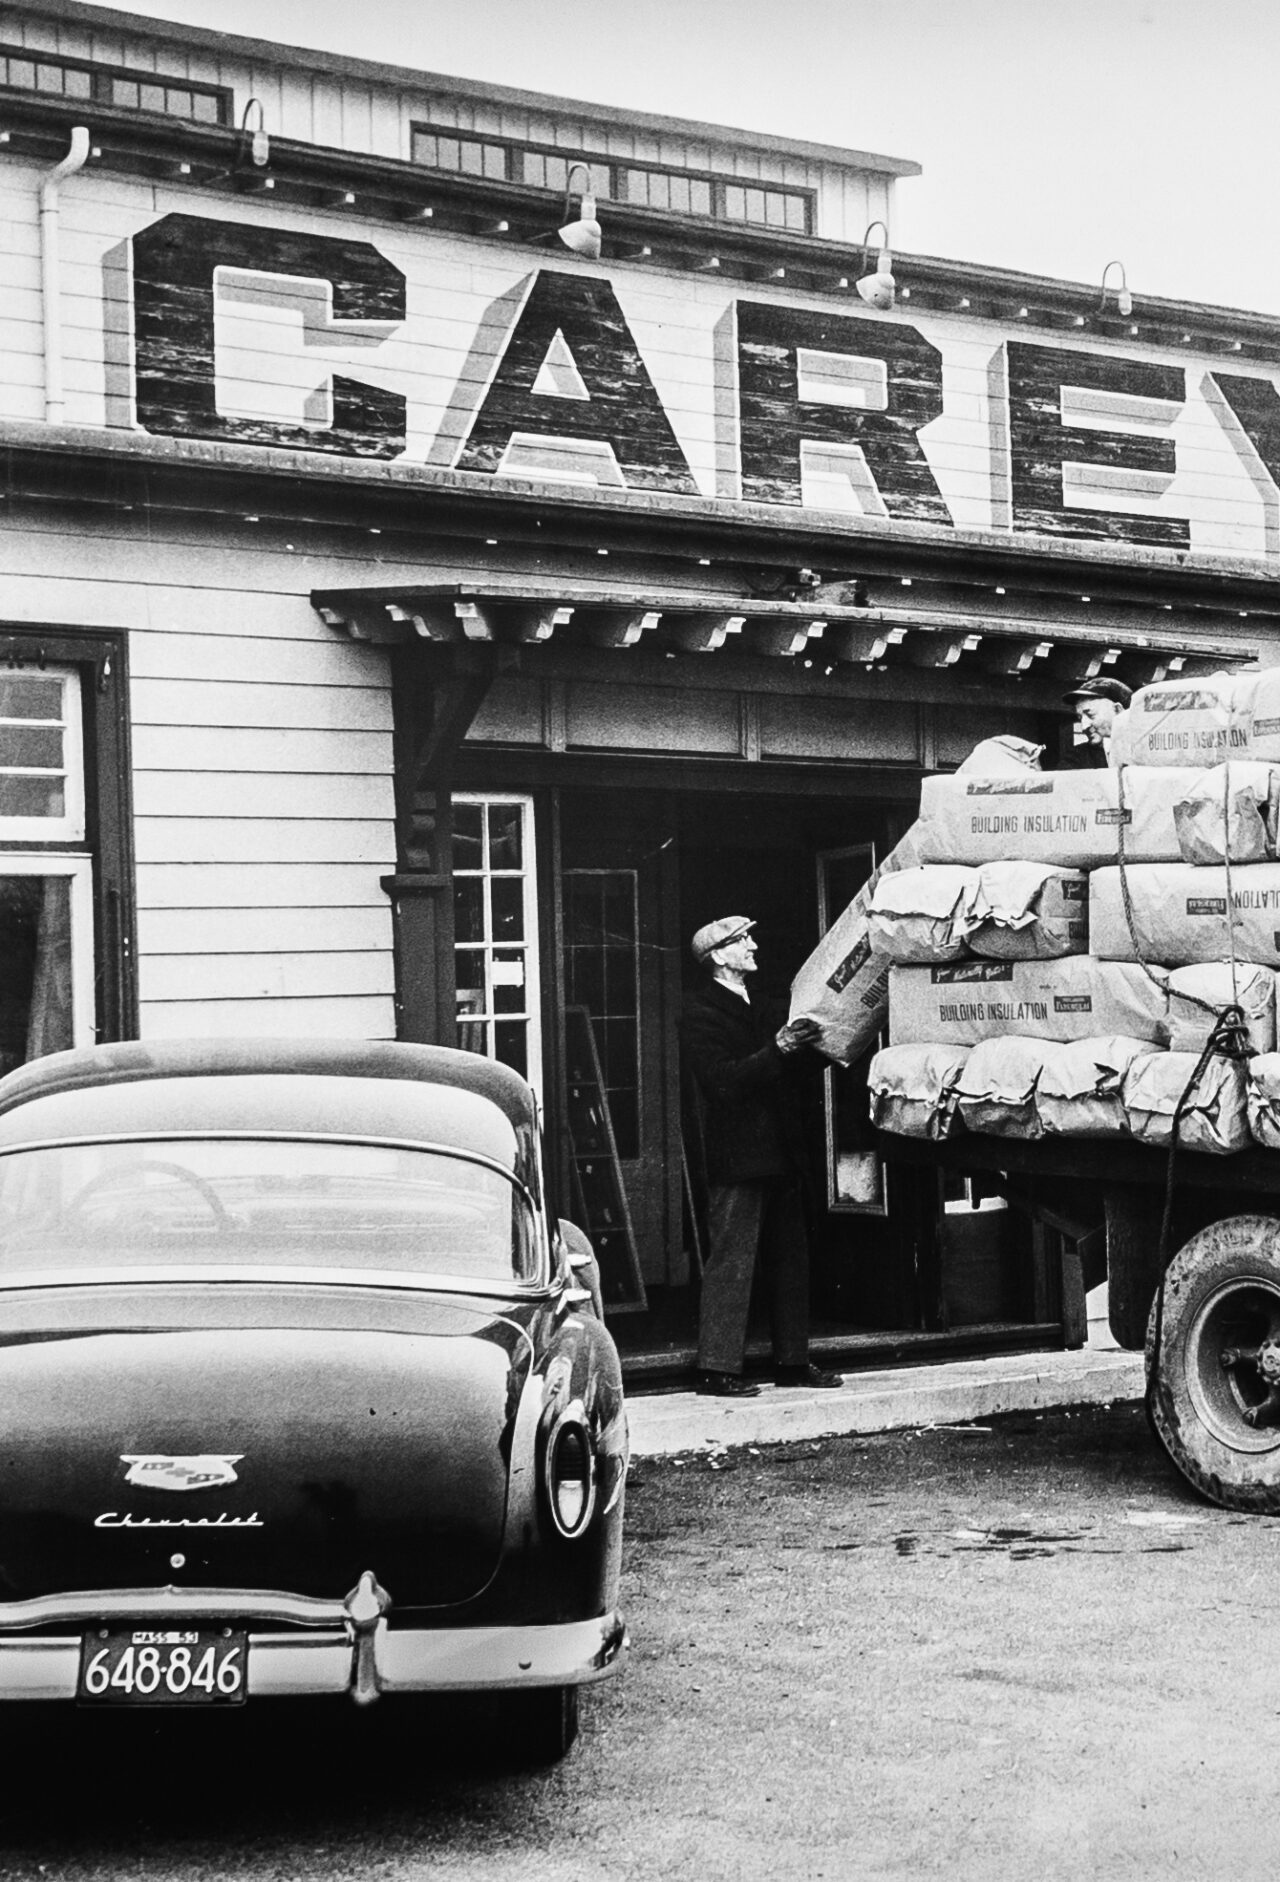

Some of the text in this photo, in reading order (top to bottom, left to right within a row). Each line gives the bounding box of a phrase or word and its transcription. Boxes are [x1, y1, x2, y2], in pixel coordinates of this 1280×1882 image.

[1149, 732, 1189, 751] BUILDING
[971, 815, 1018, 833] BUILDING
[1024, 815, 1087, 833] INSULATION
[939, 1002, 1048, 1022] BUILDING INSULATION
[94, 1512, 264, 1527] Chevrolet
